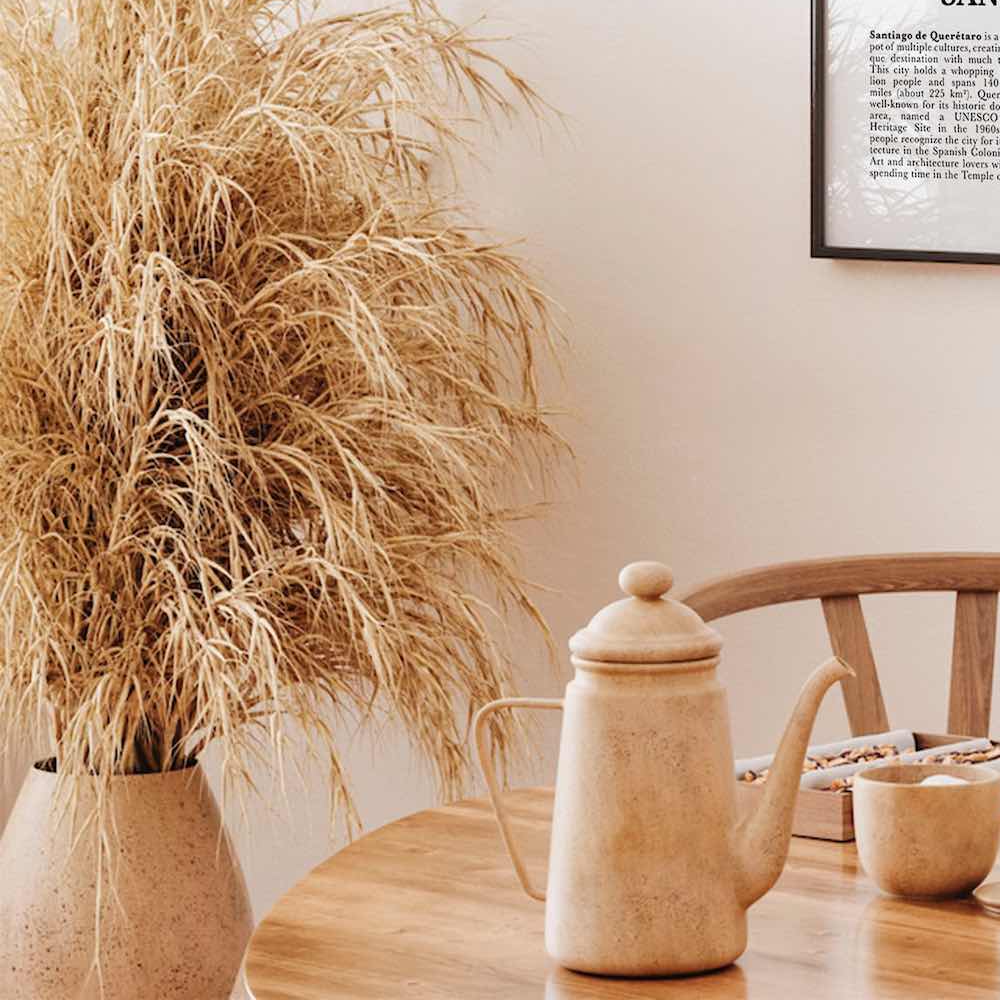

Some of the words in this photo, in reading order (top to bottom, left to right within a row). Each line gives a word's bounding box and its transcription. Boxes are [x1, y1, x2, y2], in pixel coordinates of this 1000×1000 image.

[870, 30, 913, 42] Santiago
[915, 31, 927, 40] de
[930, 31, 982, 42] Querétaro
[984, 31, 991, 40] is
[869, 56, 885, 65] que
[890, 53, 938, 63] destination
[944, 54, 963, 63] with
[968, 54, 992, 64] much
[870, 65, 889, 74] This
[894, 65, 909, 76] city
[914, 65, 937, 75] holds
[951, 66, 994, 78] whopping
[870, 99, 919, 109] well-known
[922, 100, 935, 110] for
[939, 100, 949, 110] its
[953, 101, 986, 110] historic
[869, 113, 892, 122] area,
[901, 111, 930, 121] named
[954, 112, 998, 122] UNESCO
[870, 134, 898, 146] people
[901, 135, 942, 147] recognize
[945, 135, 959, 145] the
[962, 136, 977, 147] city
[980, 136, 993, 146] for
[870, 146, 900, 155] tecture
[903, 146, 912, 156] in
[915, 146, 929, 156] the
[933, 147, 967, 159] Spanish
[870, 169, 908, 181] spending
[911, 170, 930, 179] time
[933, 170, 942, 179] in
[945, 170, 958, 180] the
[962, 171, 994, 183] Temple
